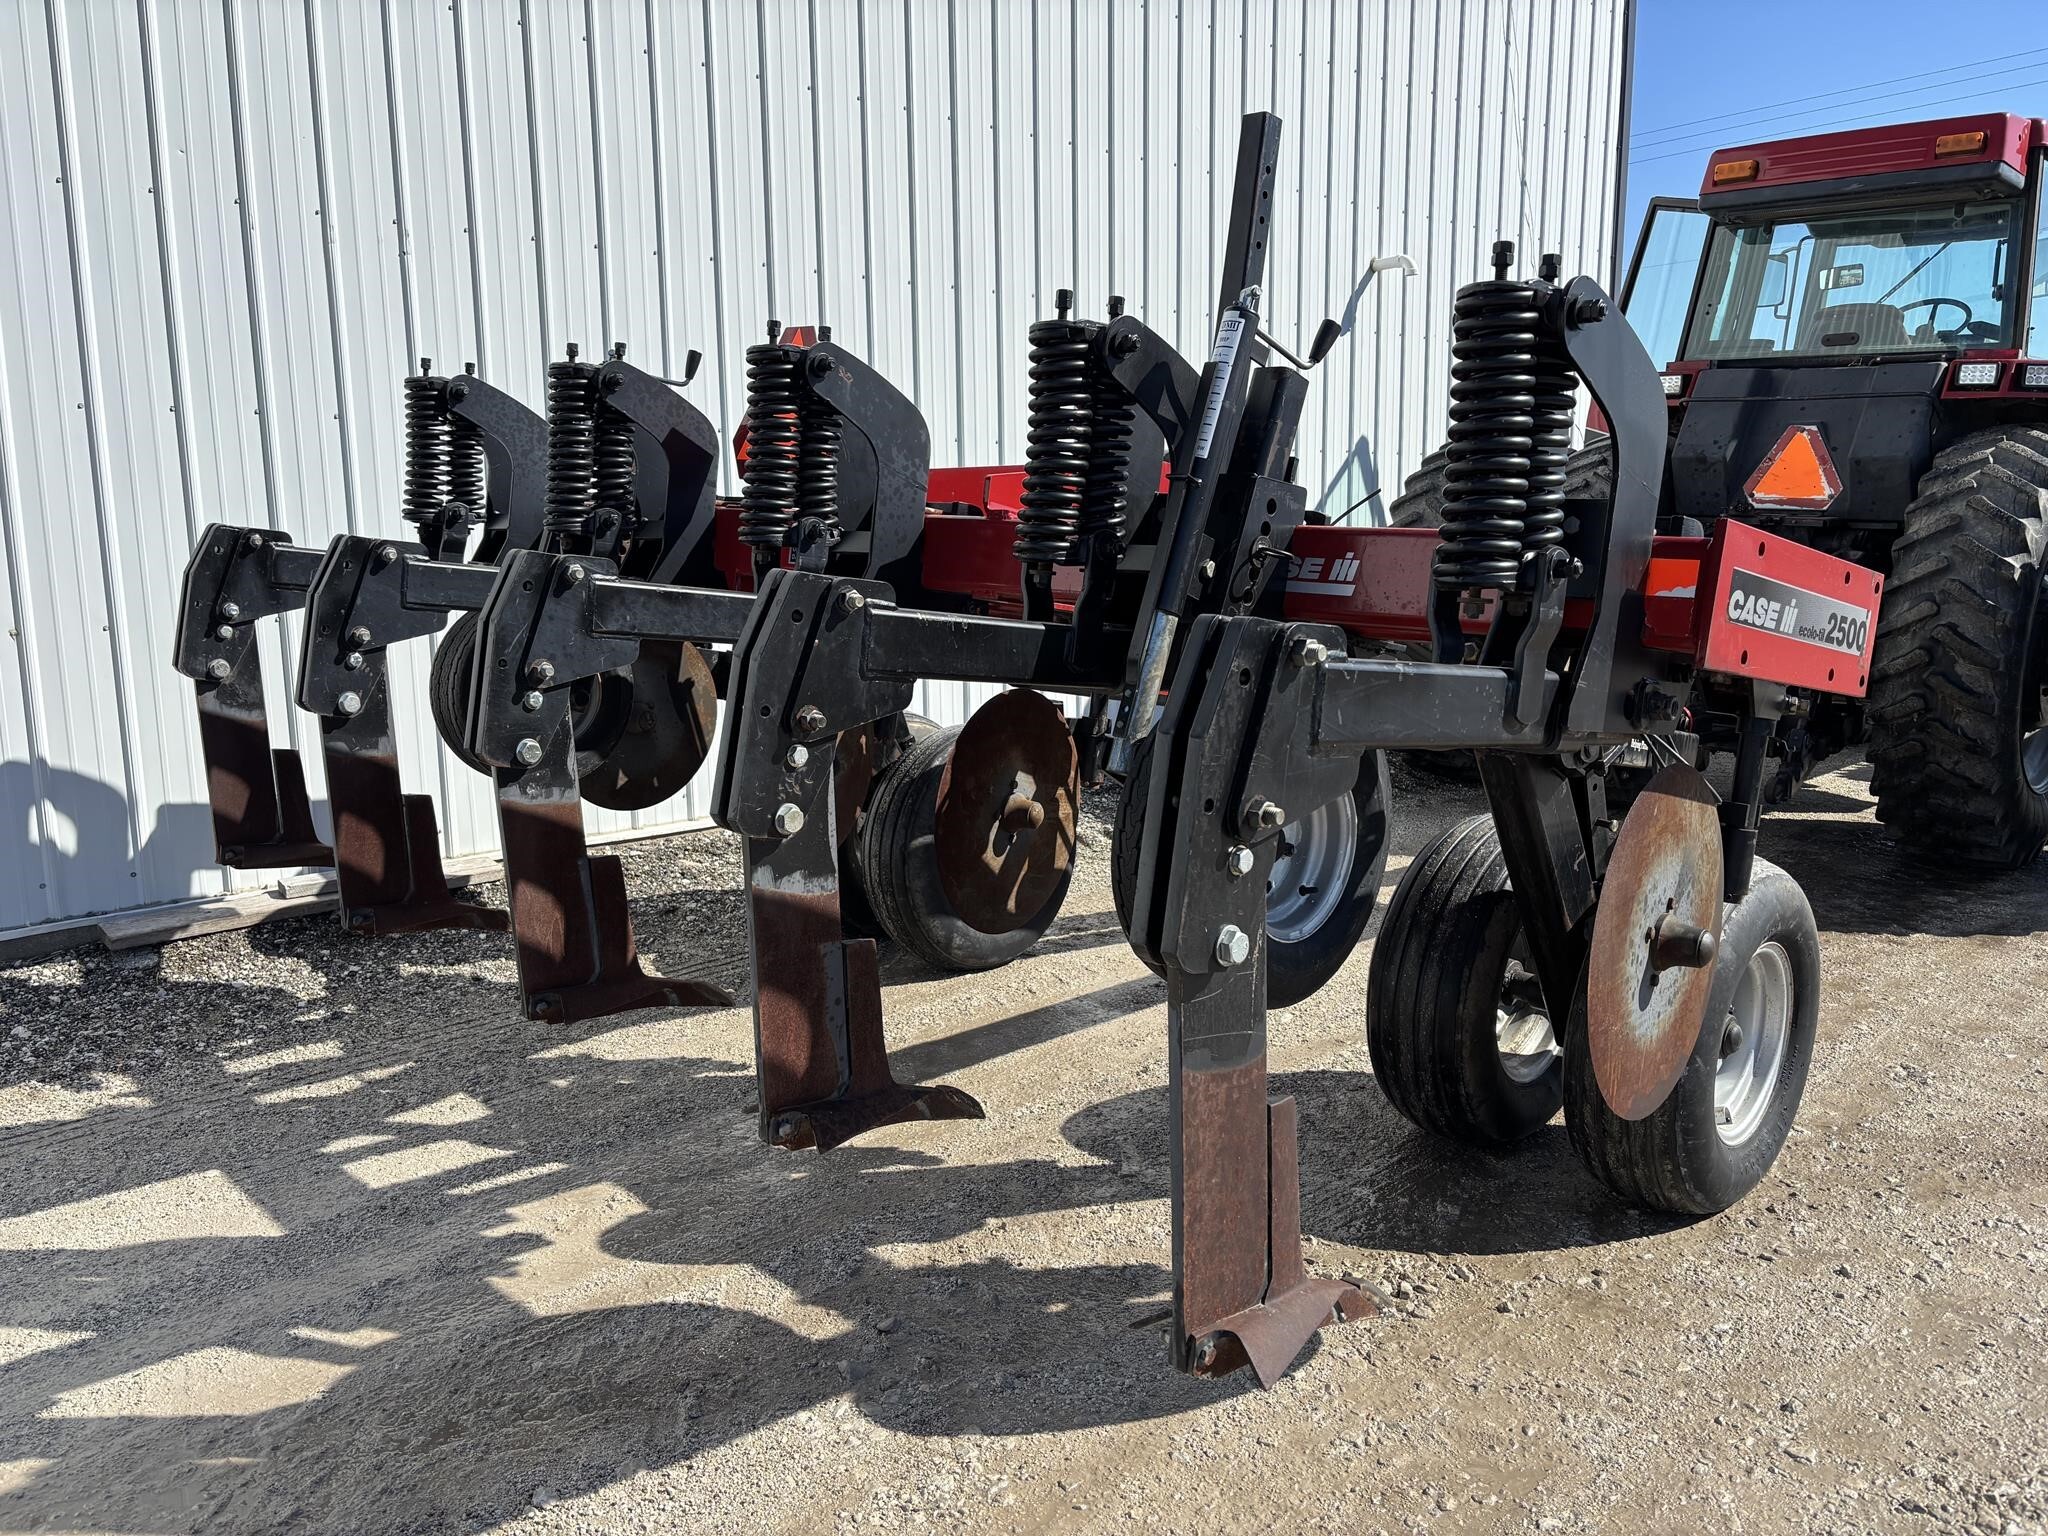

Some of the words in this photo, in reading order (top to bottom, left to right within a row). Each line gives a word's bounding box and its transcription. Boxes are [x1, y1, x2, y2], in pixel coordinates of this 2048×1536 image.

[1287, 556, 1326, 580] SE
[1728, 589, 1781, 630] CASE
[1824, 612, 1867, 652] 2500
